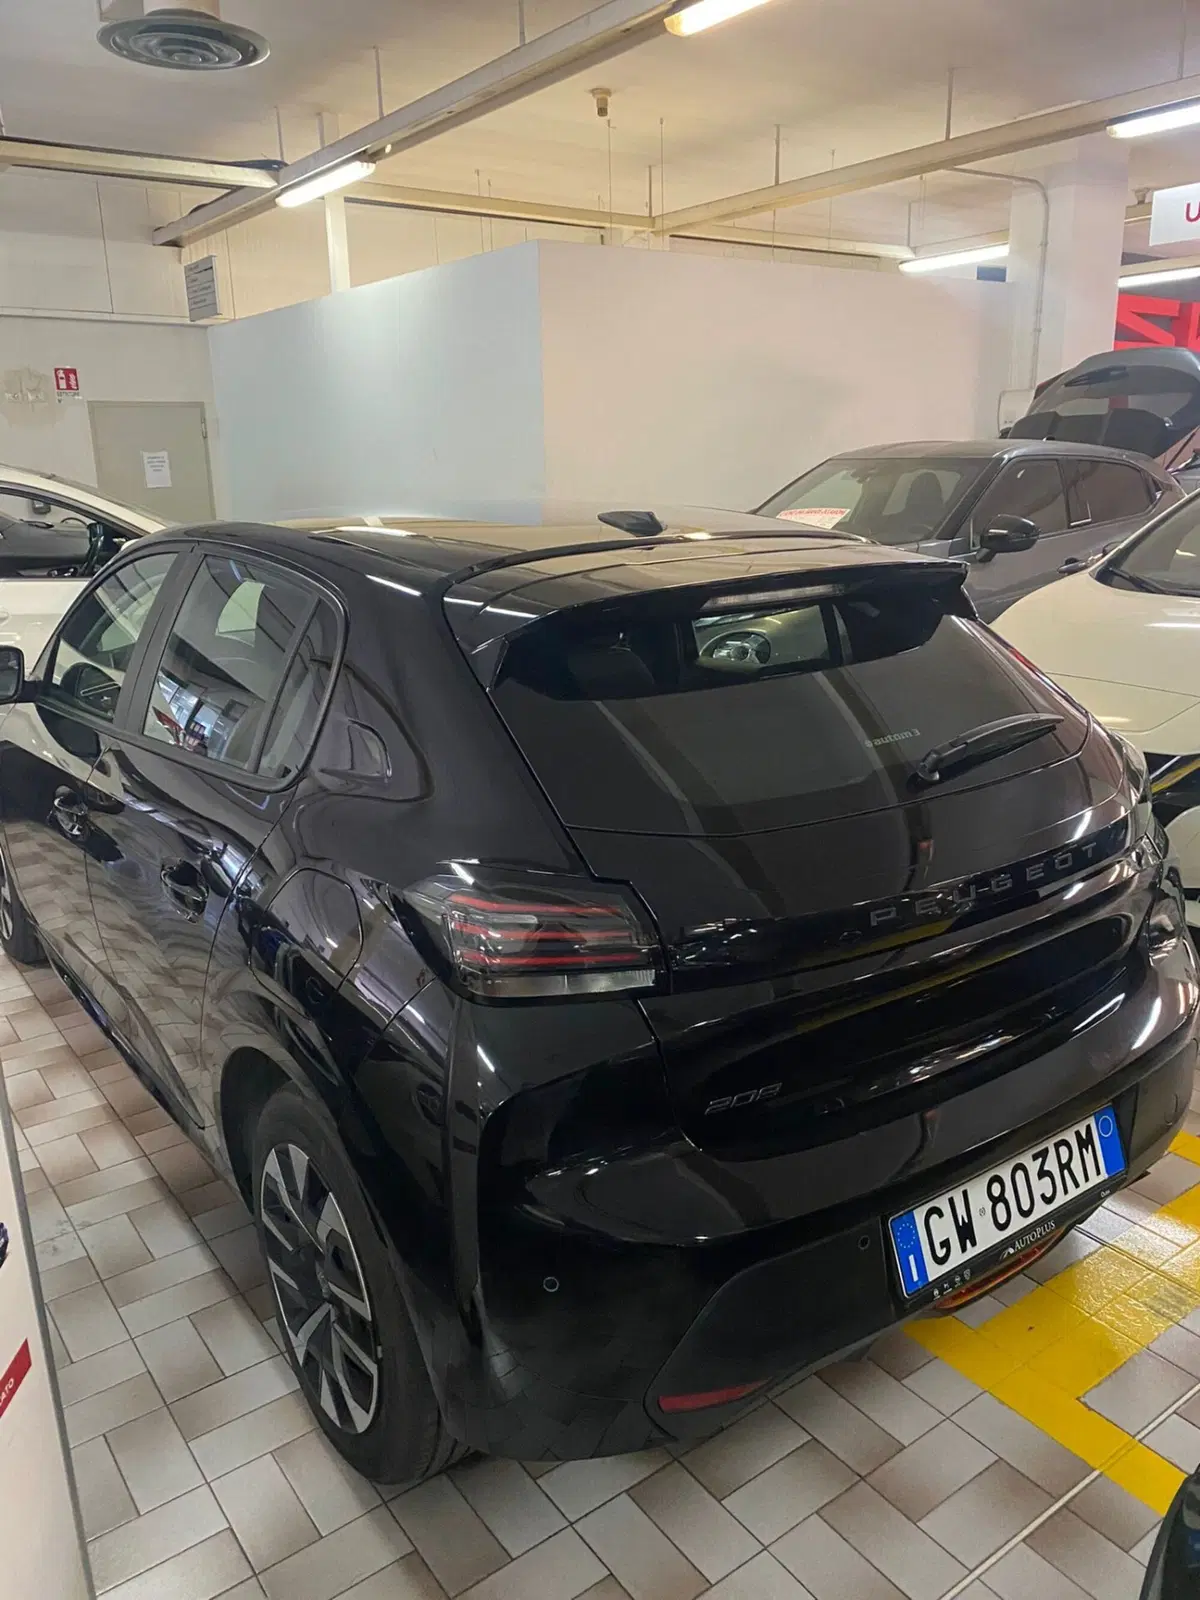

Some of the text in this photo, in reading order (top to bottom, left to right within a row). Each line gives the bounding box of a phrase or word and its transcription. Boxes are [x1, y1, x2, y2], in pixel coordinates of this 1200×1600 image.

[869, 842, 1097, 926] PEUGEOT
[924, 1123, 1101, 1266] GW 803RM
[1014, 1220, 1056, 1252] AUTOPLUS
